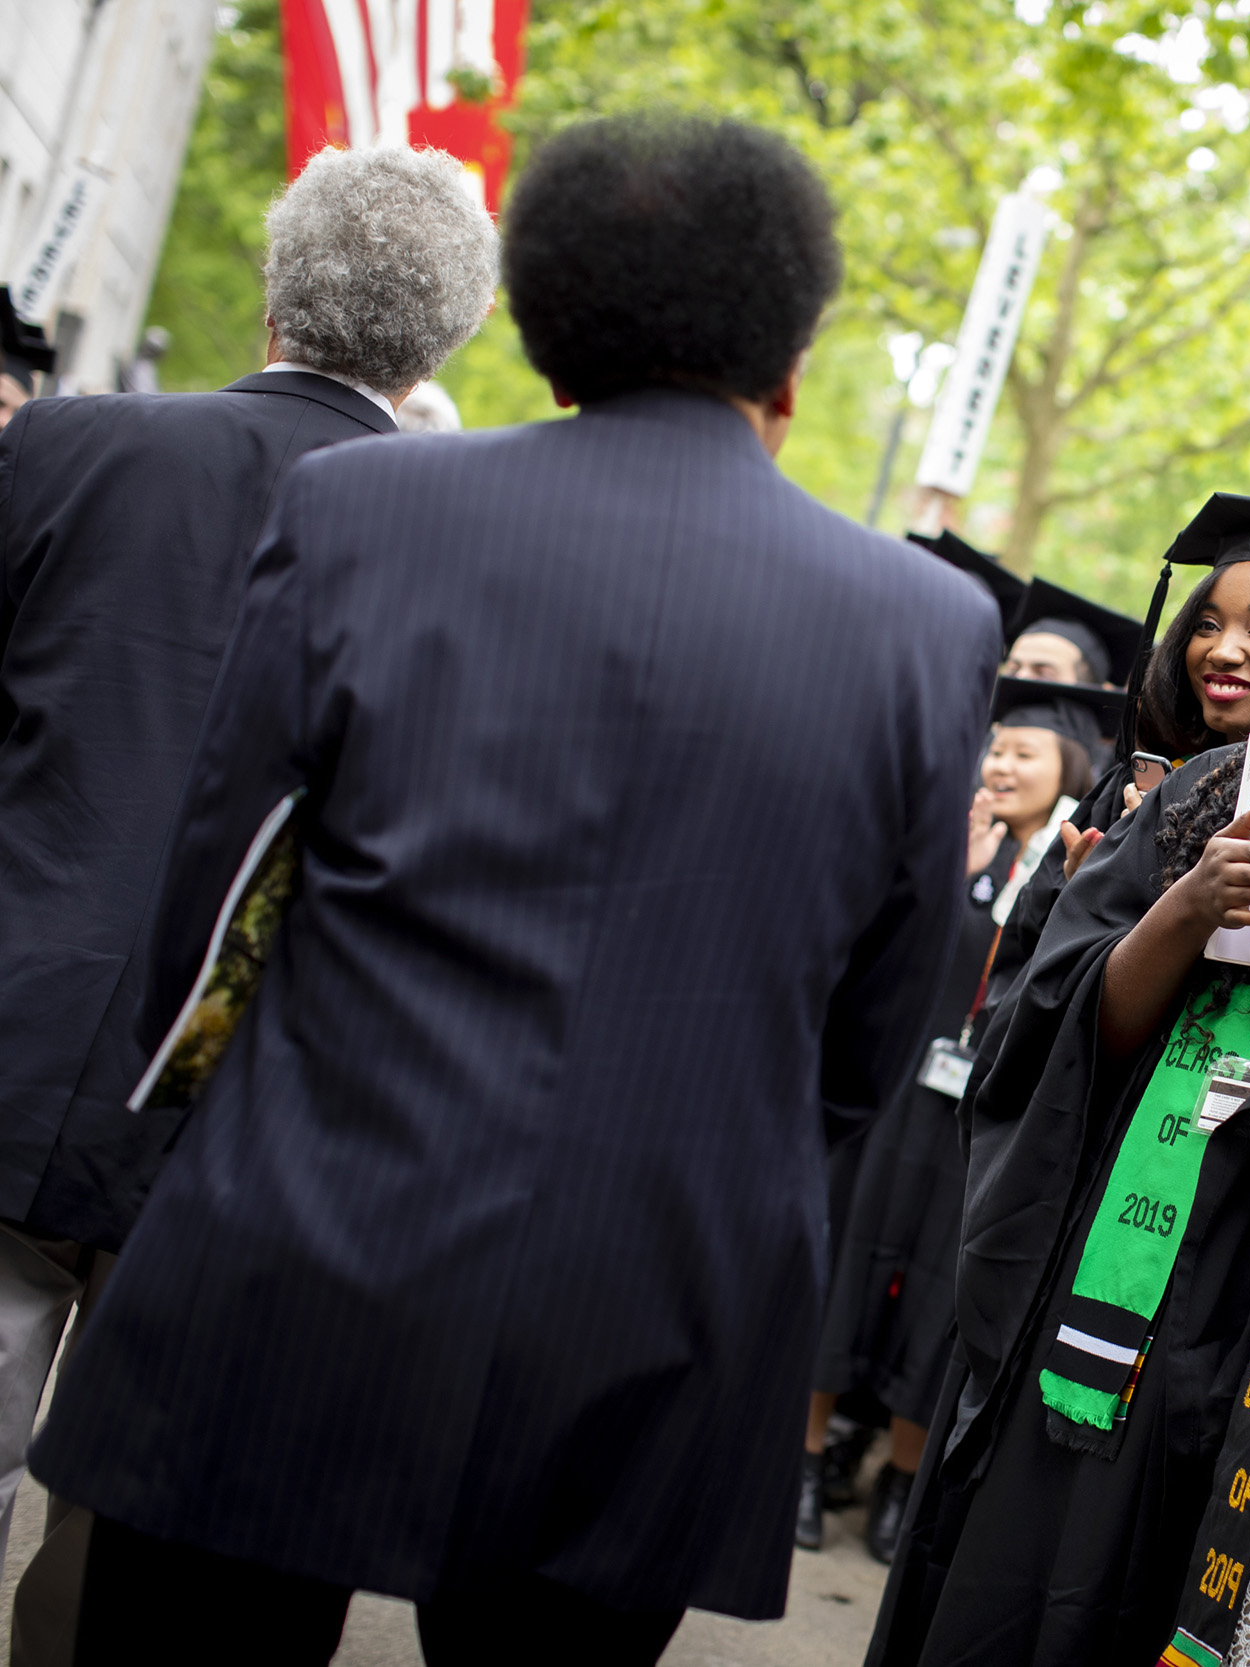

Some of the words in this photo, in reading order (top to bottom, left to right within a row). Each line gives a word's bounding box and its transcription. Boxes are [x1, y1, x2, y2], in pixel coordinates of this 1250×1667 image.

[950, 231, 1027, 475] LEVERETT
[1165, 1038, 1240, 1080] CLASS
[1157, 1112, 1191, 1147] OF
[1117, 1192, 1178, 1239] 2019
[1199, 1546, 1245, 1611] 2019
